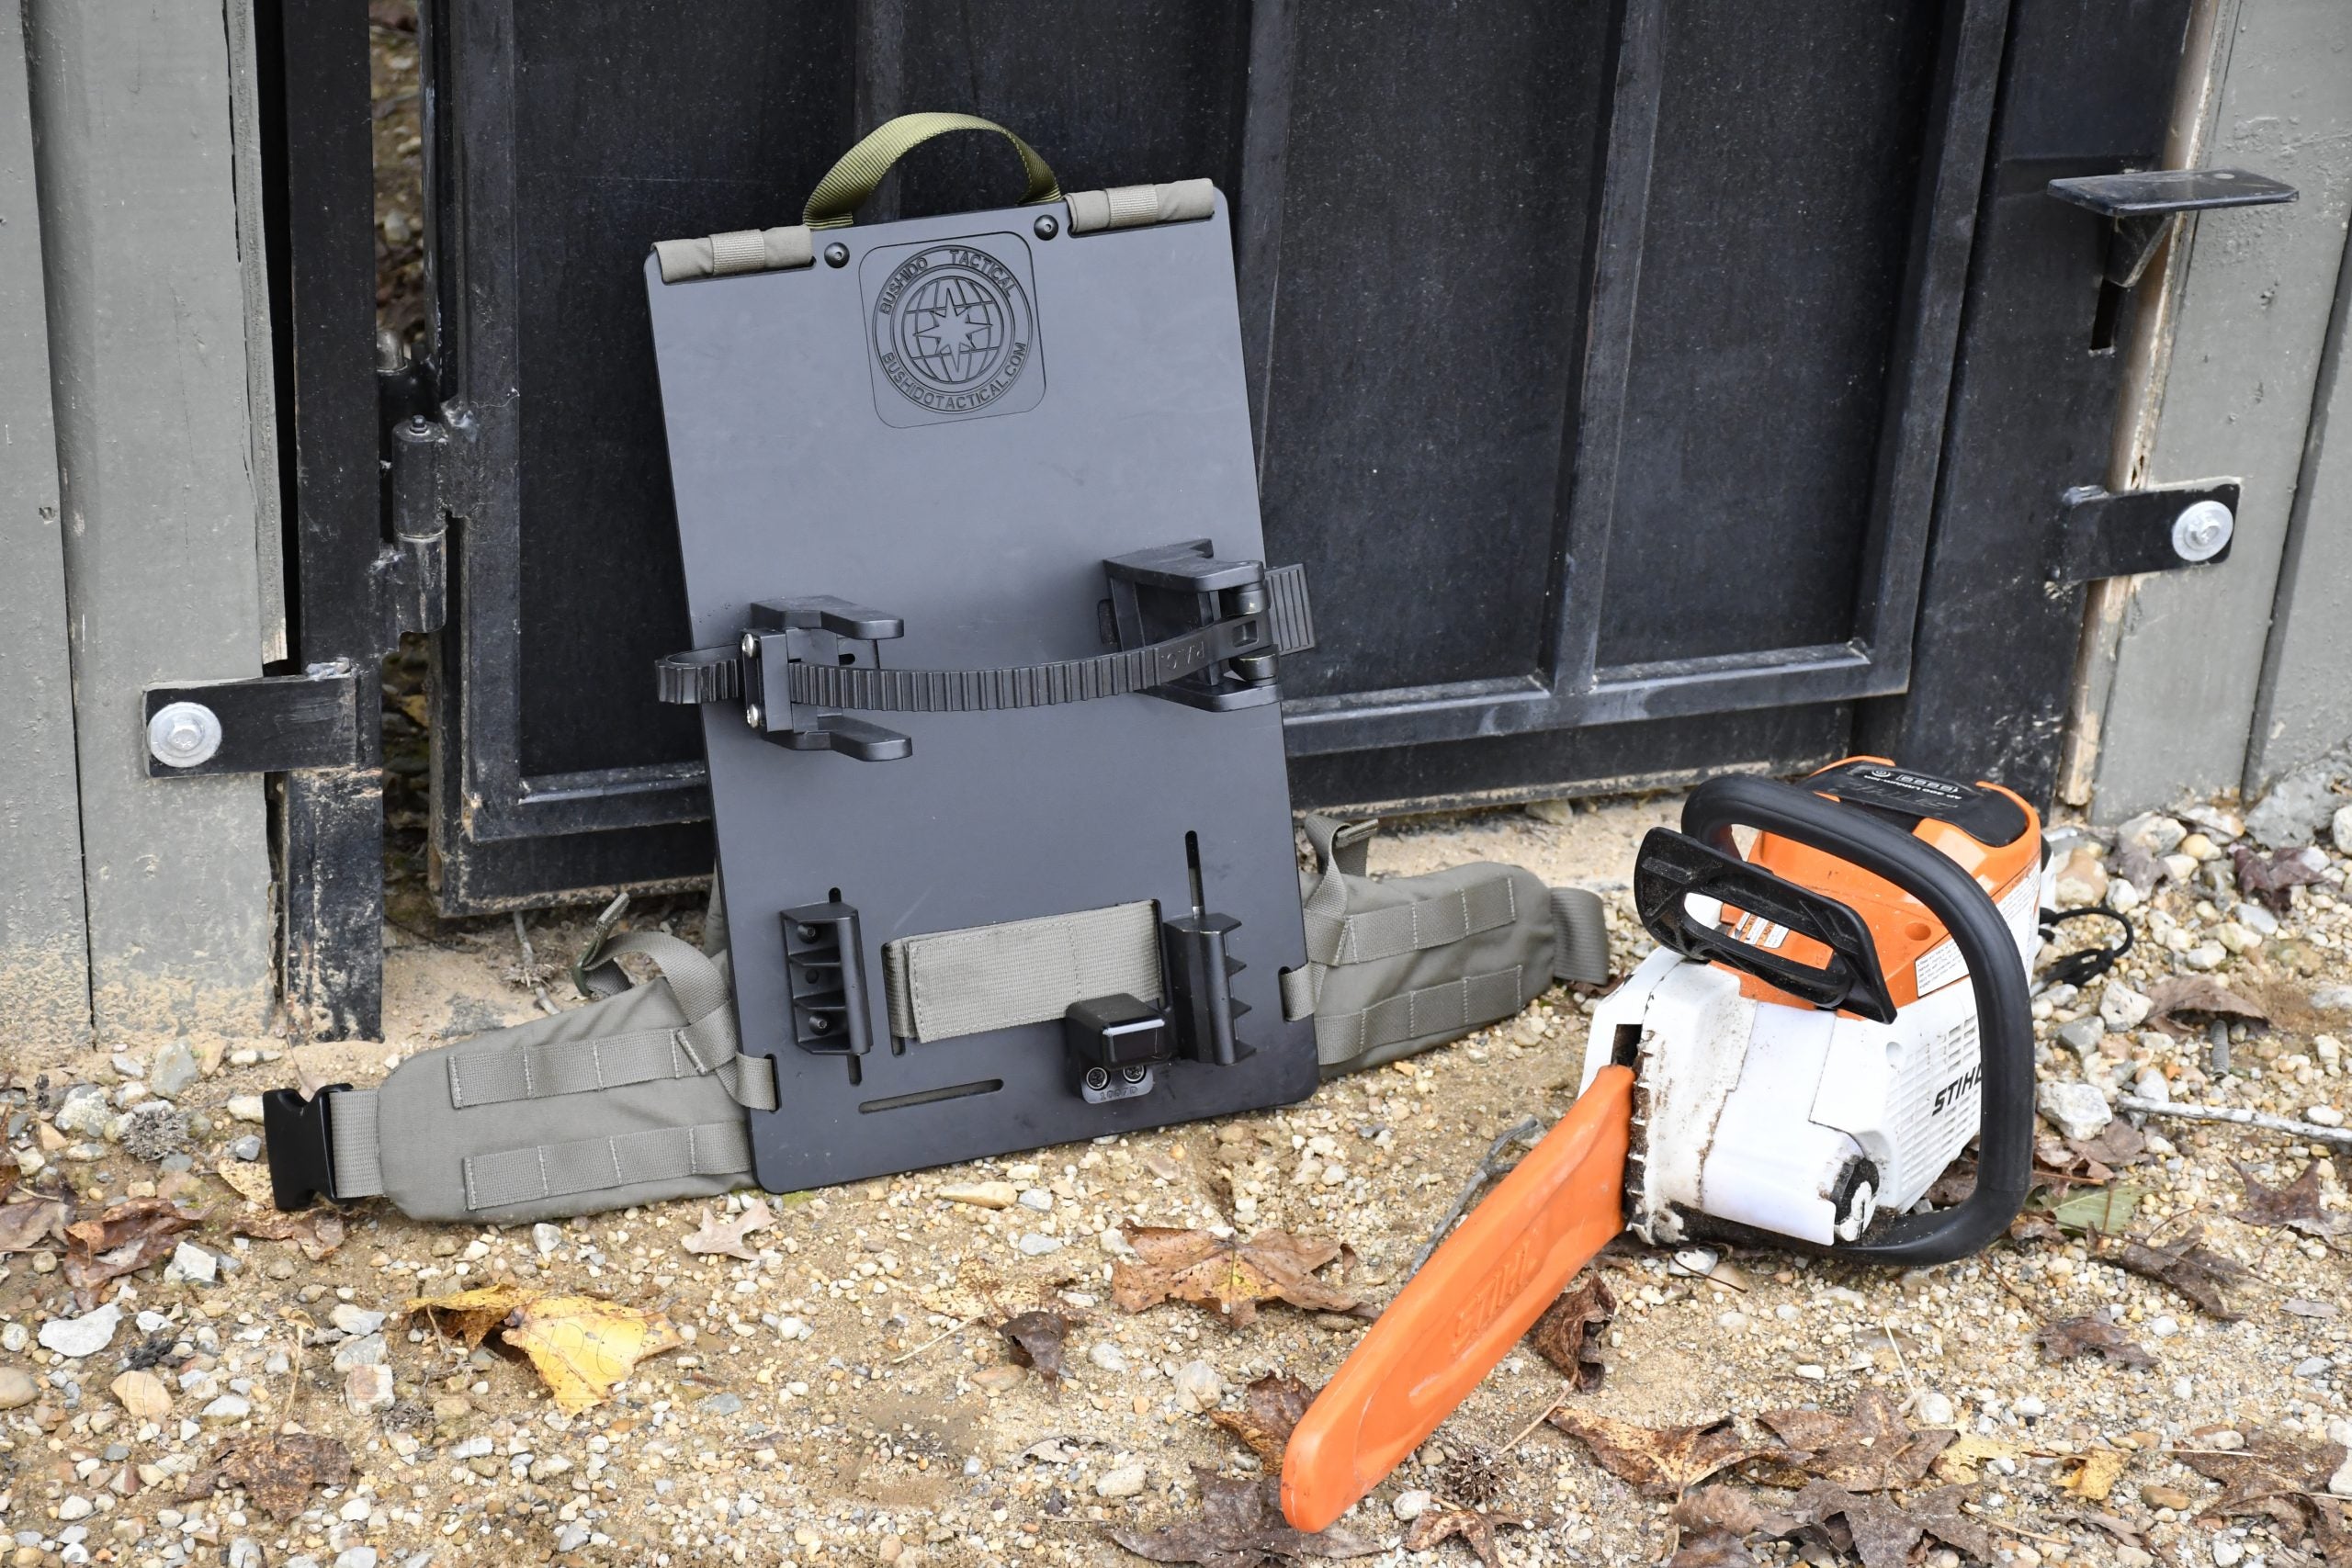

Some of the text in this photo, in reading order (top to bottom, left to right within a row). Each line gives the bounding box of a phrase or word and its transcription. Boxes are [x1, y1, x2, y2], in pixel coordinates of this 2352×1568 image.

[879, 250, 1016, 315] BUSHIDO TACTICAL
[881, 342, 1027, 411] BUSHIDOTACTICAL.COM
[1931, 1063, 1983, 1117] STIHL
